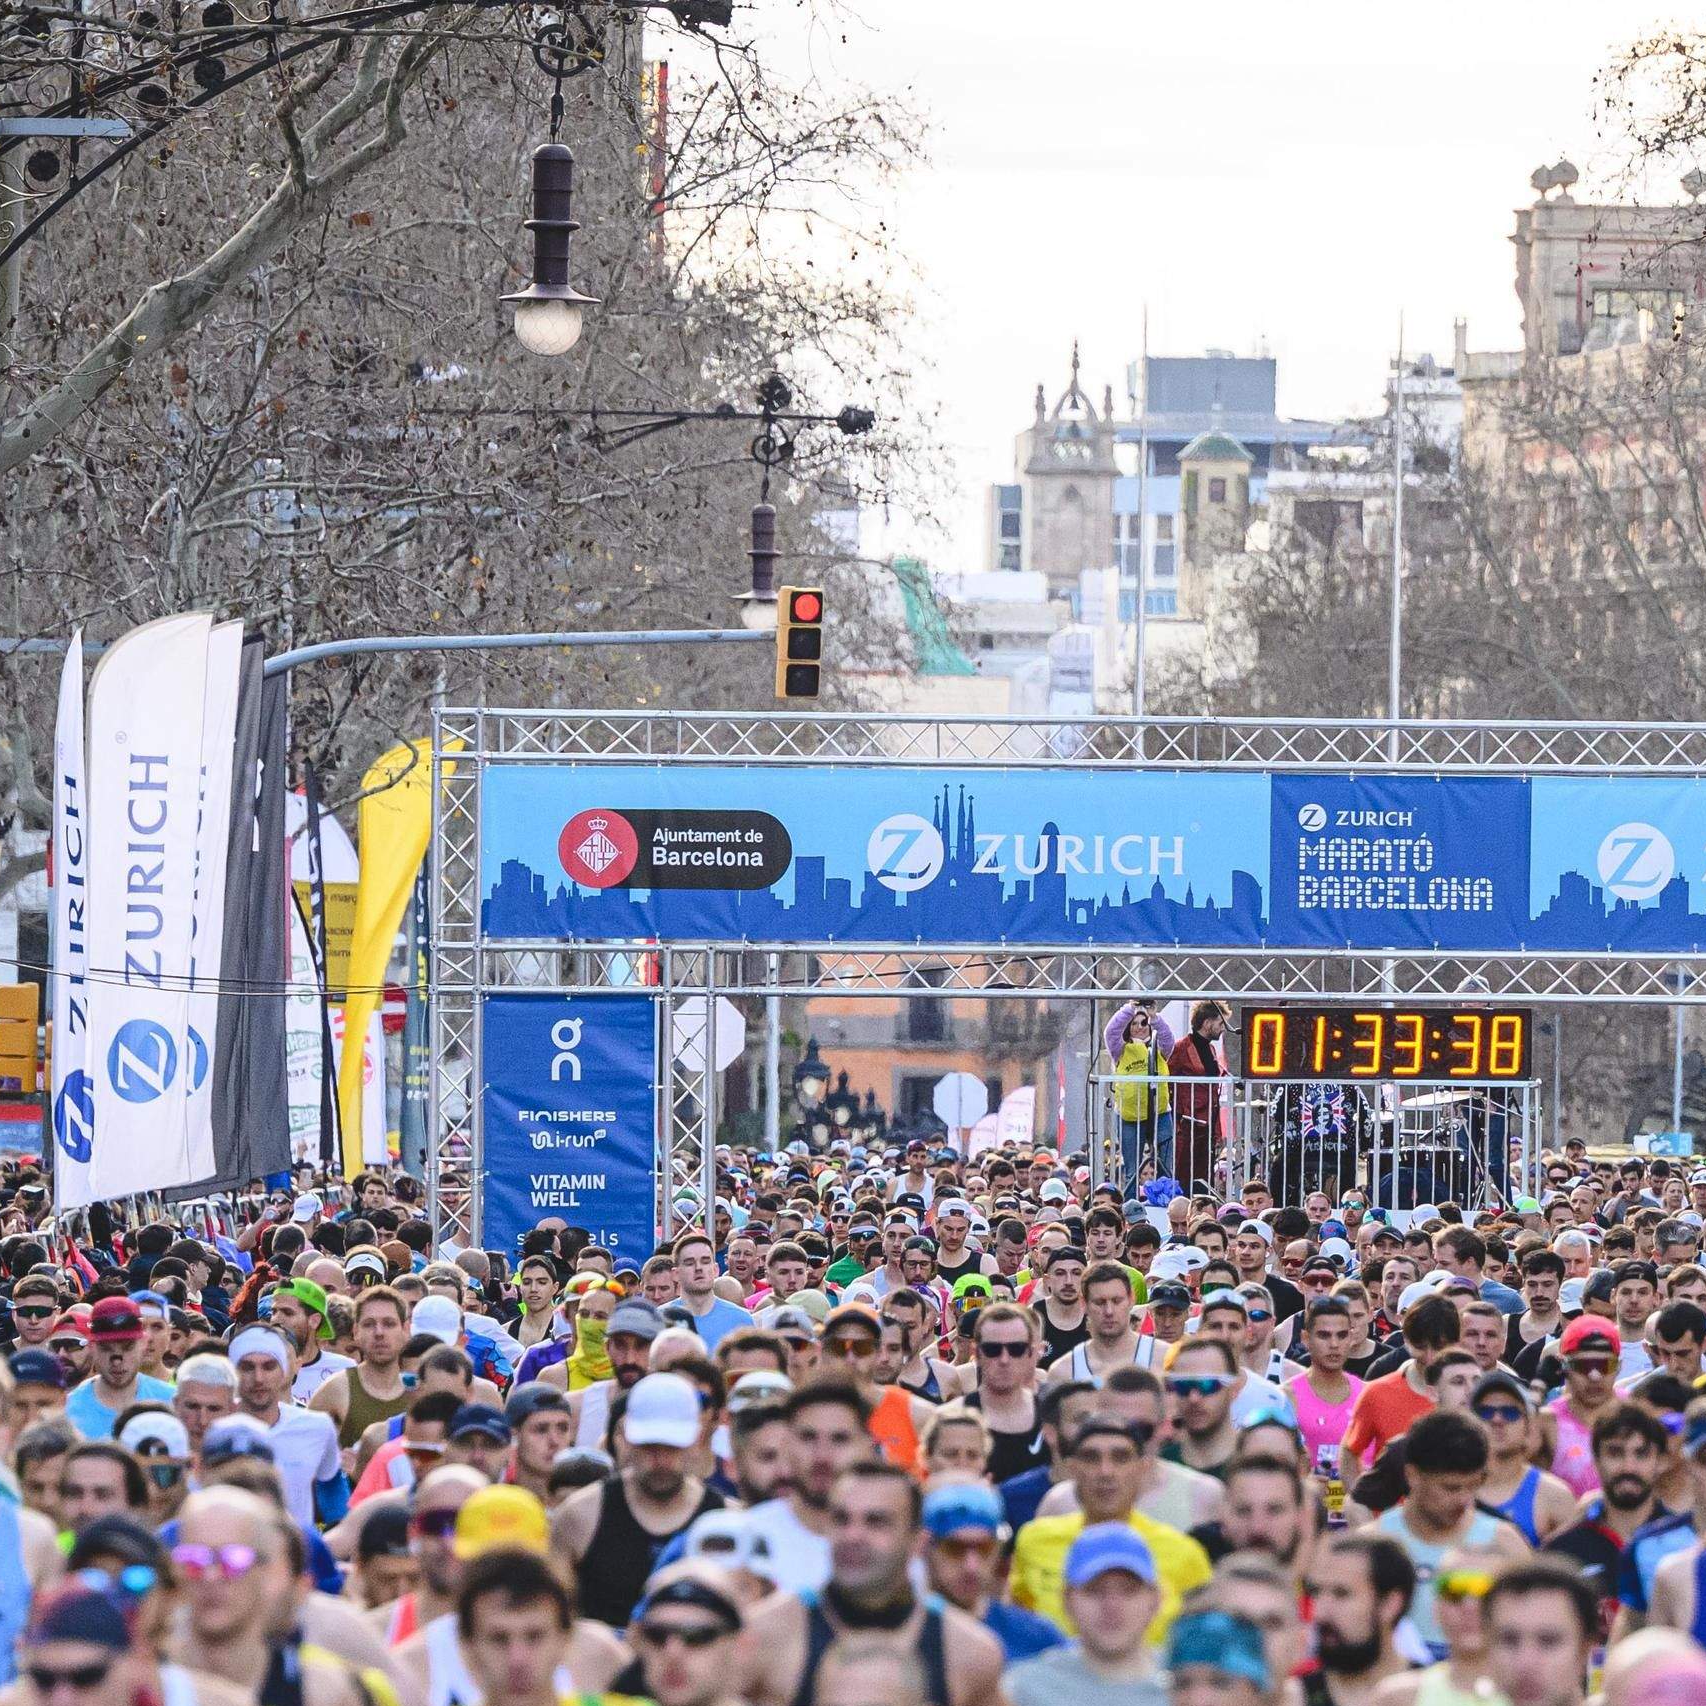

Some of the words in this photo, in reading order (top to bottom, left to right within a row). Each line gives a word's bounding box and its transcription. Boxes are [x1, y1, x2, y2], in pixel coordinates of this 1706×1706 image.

[1334, 810, 1414, 828] ZURICH
[652, 828, 740, 846] Ajuntament
[744, 828, 764, 844] de
[652, 847, 764, 867] Barcelona
[971, 833, 1184, 876] ZURICH
[1298, 831, 1434, 873] MARATÓ
[124, 752, 170, 989] ZURICH
[1298, 875, 1494, 911] BARCELONA
[1250, 1012, 1523, 1076] 01:33:38
[518, 1110, 617, 1122] FINISHERS
[530, 1174, 606, 1191] VITAMIN
[530, 1191, 581, 1207] WELL
